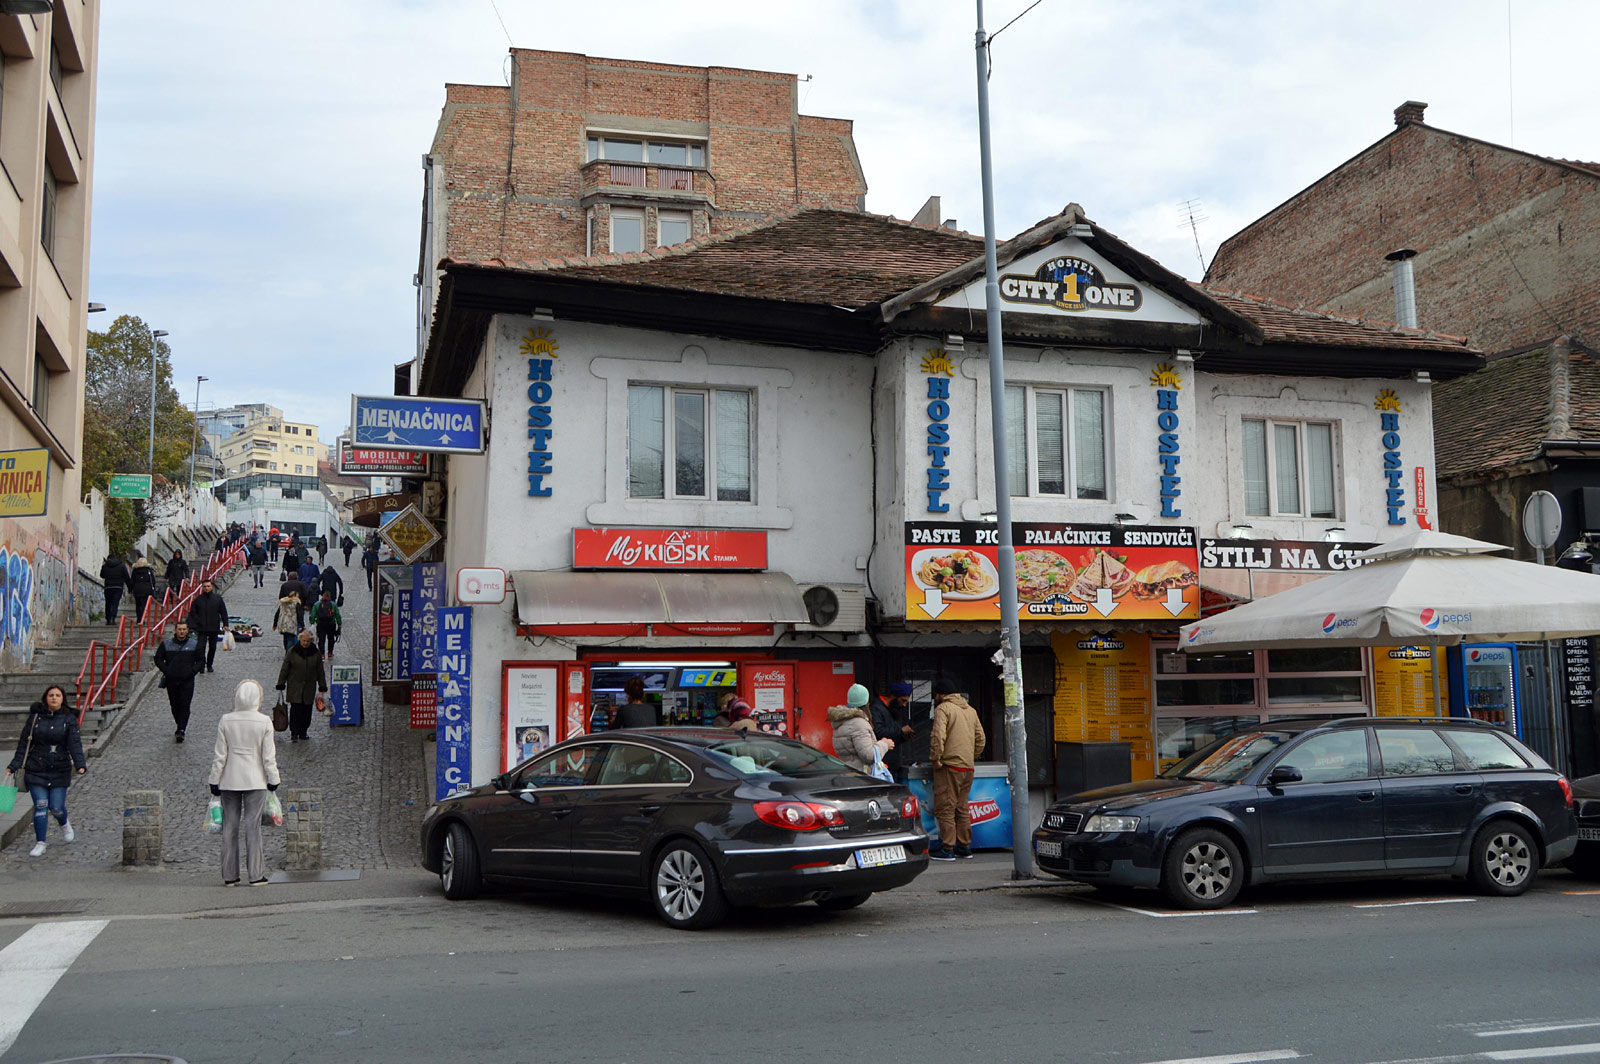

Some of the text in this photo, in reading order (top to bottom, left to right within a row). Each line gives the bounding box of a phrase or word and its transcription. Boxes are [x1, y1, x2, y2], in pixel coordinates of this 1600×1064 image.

[1047, 259, 1094, 275] HOSTEL
[1001, 273, 1134, 306] CITY 1 ONE
[361, 406, 474, 432] MENJAČNICA
[528, 359, 552, 497] HOSTEL
[927, 377, 950, 513] HOSTEL
[360, 451, 409, 460] MOBILNI
[1157, 390, 1181, 518] HOSTEL
[1381, 413, 1406, 525] HOSTEL
[911, 526, 1193, 545] PASTE PIC PALAČINKE SENDVIČI
[1200, 540, 1272, 568] ŠTILJ
[1280, 549, 1320, 569] NA
[484, 582, 500, 590] mts
[1029, 604, 1087, 612] CITY KING
[1336, 616, 1358, 628] pepsi
[1442, 612, 1472, 624] pepsi
[1482, 651, 1505, 661] pepsi
[968, 803, 998, 819] ikom
[862, 850, 873, 863] BG
